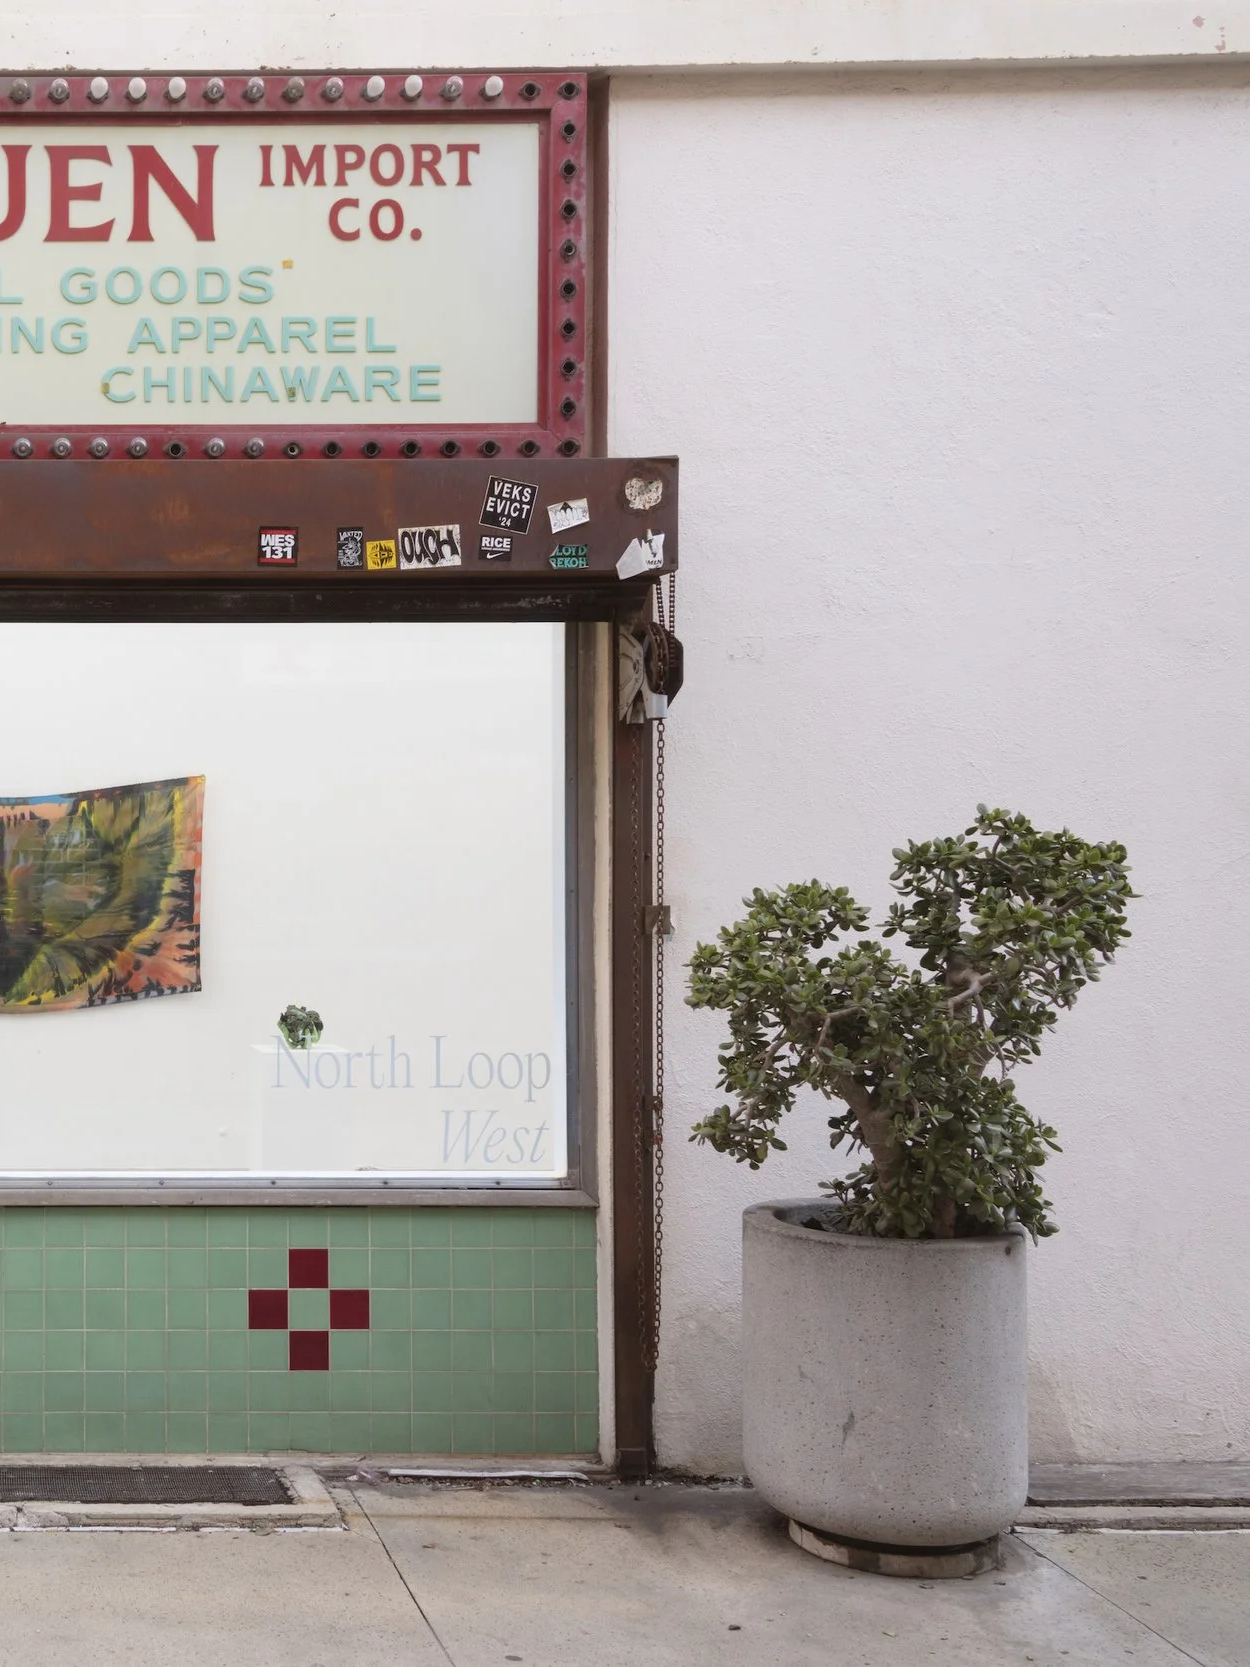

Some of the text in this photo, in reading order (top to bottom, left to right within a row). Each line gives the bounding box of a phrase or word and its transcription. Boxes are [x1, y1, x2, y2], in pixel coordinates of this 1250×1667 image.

[258, 143, 481, 187] IMPORT
[328, 197, 423, 242] CO.
[60, 266, 275, 305] GOODS
[127, 316, 397, 354] APPAREL
[103, 365, 442, 403] CHINAWARE
[486, 497, 530, 519] EVICT
[493, 481, 532, 501] VEKS
[261, 534, 295, 547] WES
[262, 547, 293, 559] 131
[482, 536, 511, 548] RICE
[270, 1035, 551, 1103] North Loop
[440, 1110, 550, 1164] West
